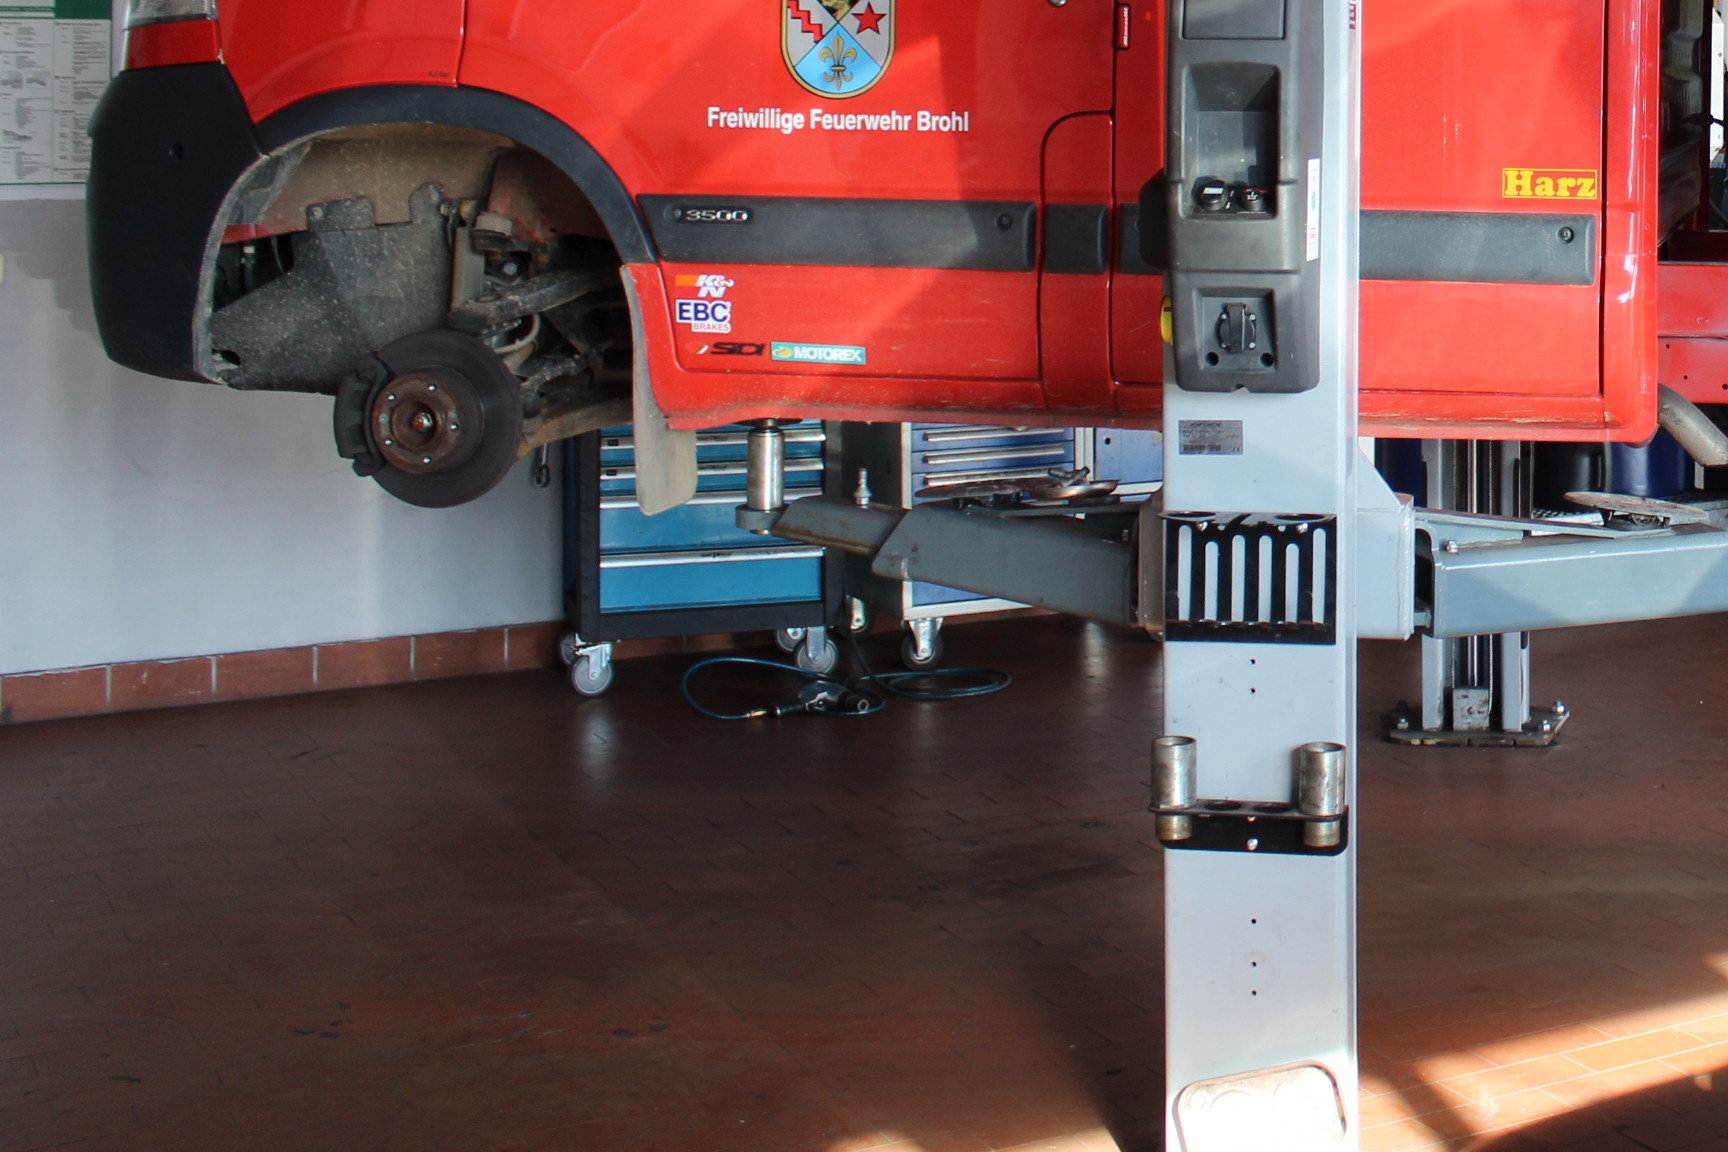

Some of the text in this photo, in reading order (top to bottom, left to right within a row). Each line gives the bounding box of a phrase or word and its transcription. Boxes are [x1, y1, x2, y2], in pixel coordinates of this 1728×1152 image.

[707, 107, 969, 134] Freiwillige Feuerwehr Brohl
[1505, 170, 1596, 196] Harz
[686, 209, 749, 222] 3500
[678, 302, 729, 322] EBC
[693, 323, 730, 332] BRAKES
[793, 346, 862, 362] MOTOREX
